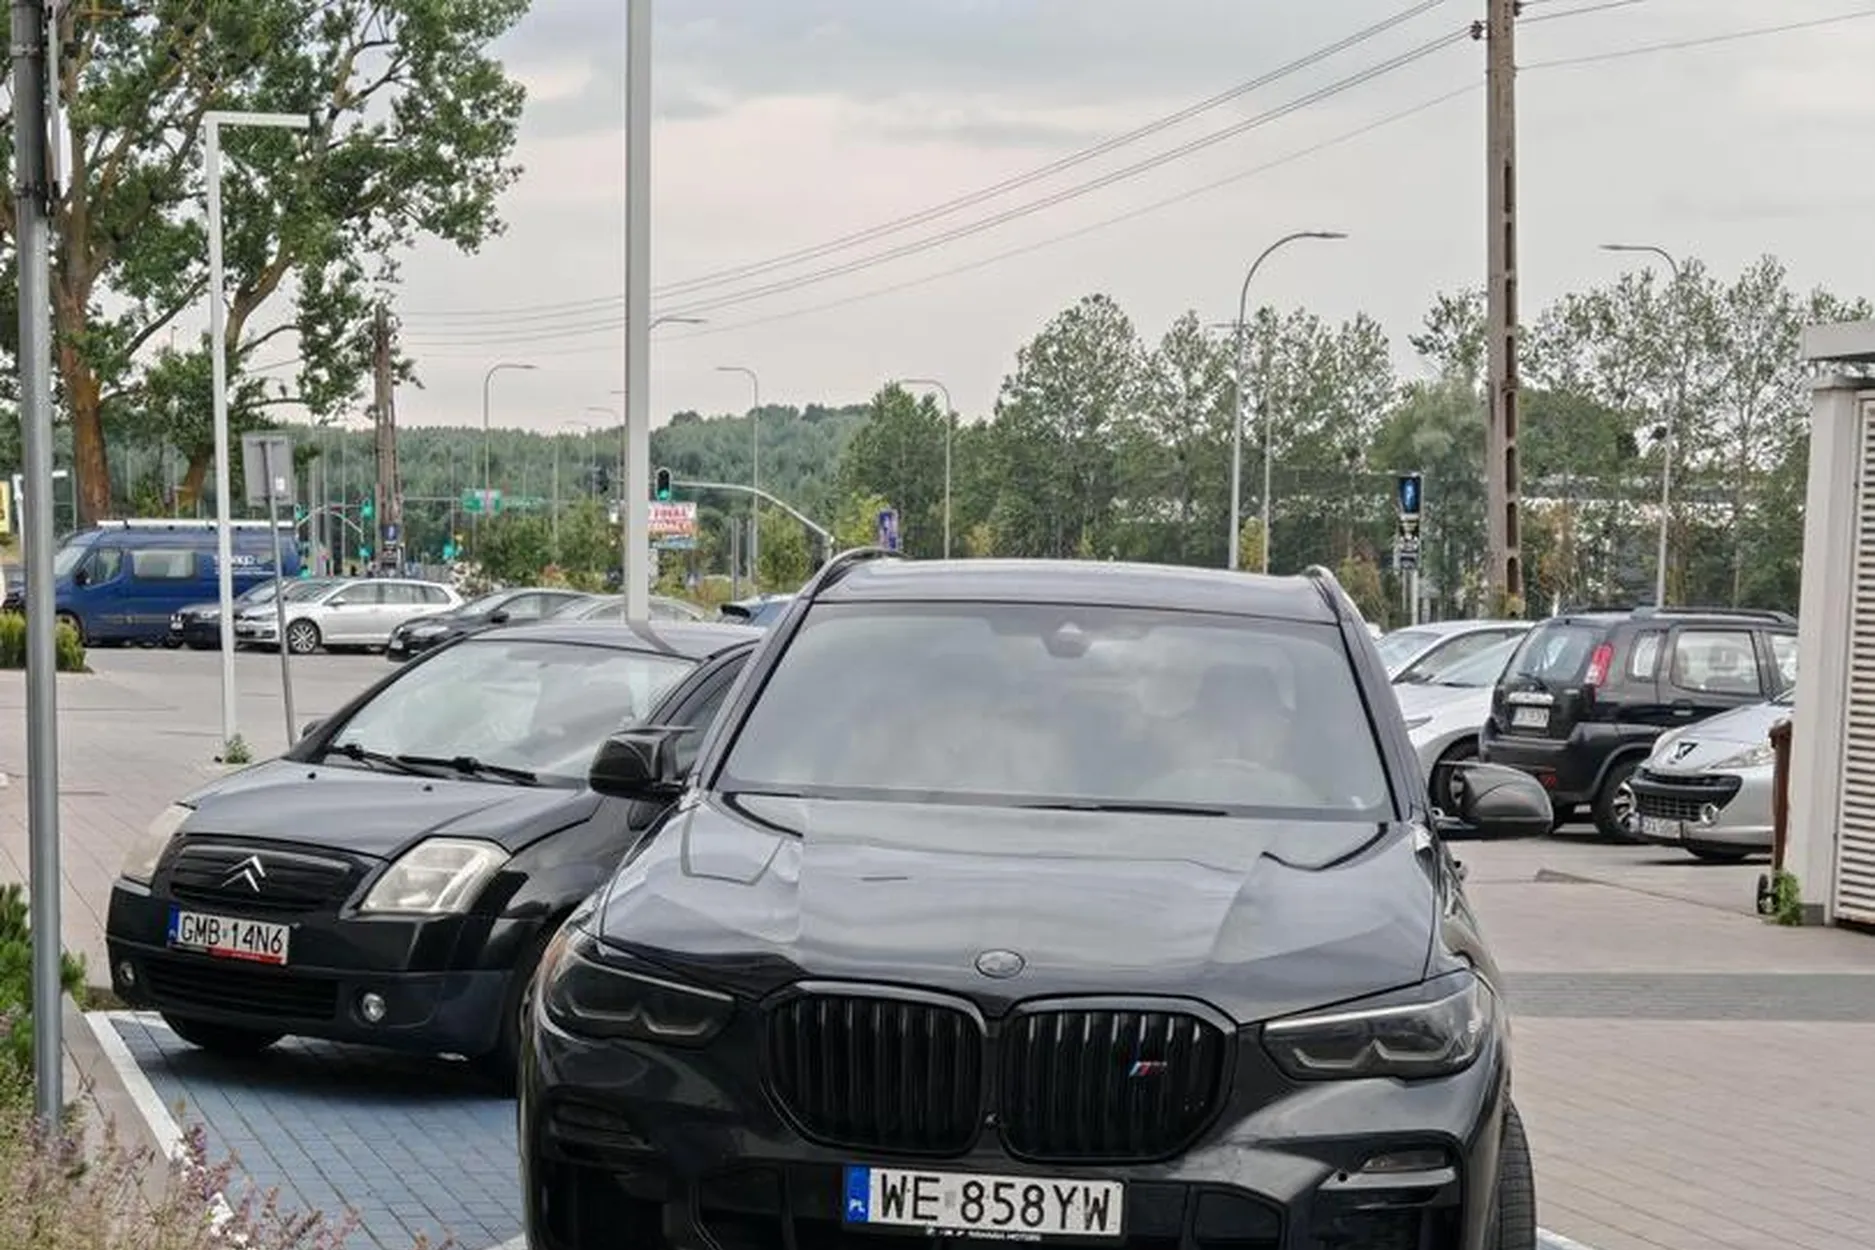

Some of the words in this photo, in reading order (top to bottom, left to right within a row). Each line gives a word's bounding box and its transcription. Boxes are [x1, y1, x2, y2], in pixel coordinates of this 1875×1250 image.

[181, 915, 220, 946] GMB
[232, 922, 283, 954] 14N6
[881, 1173, 941, 1221] WE
[960, 1179, 1111, 1232] 858YW
